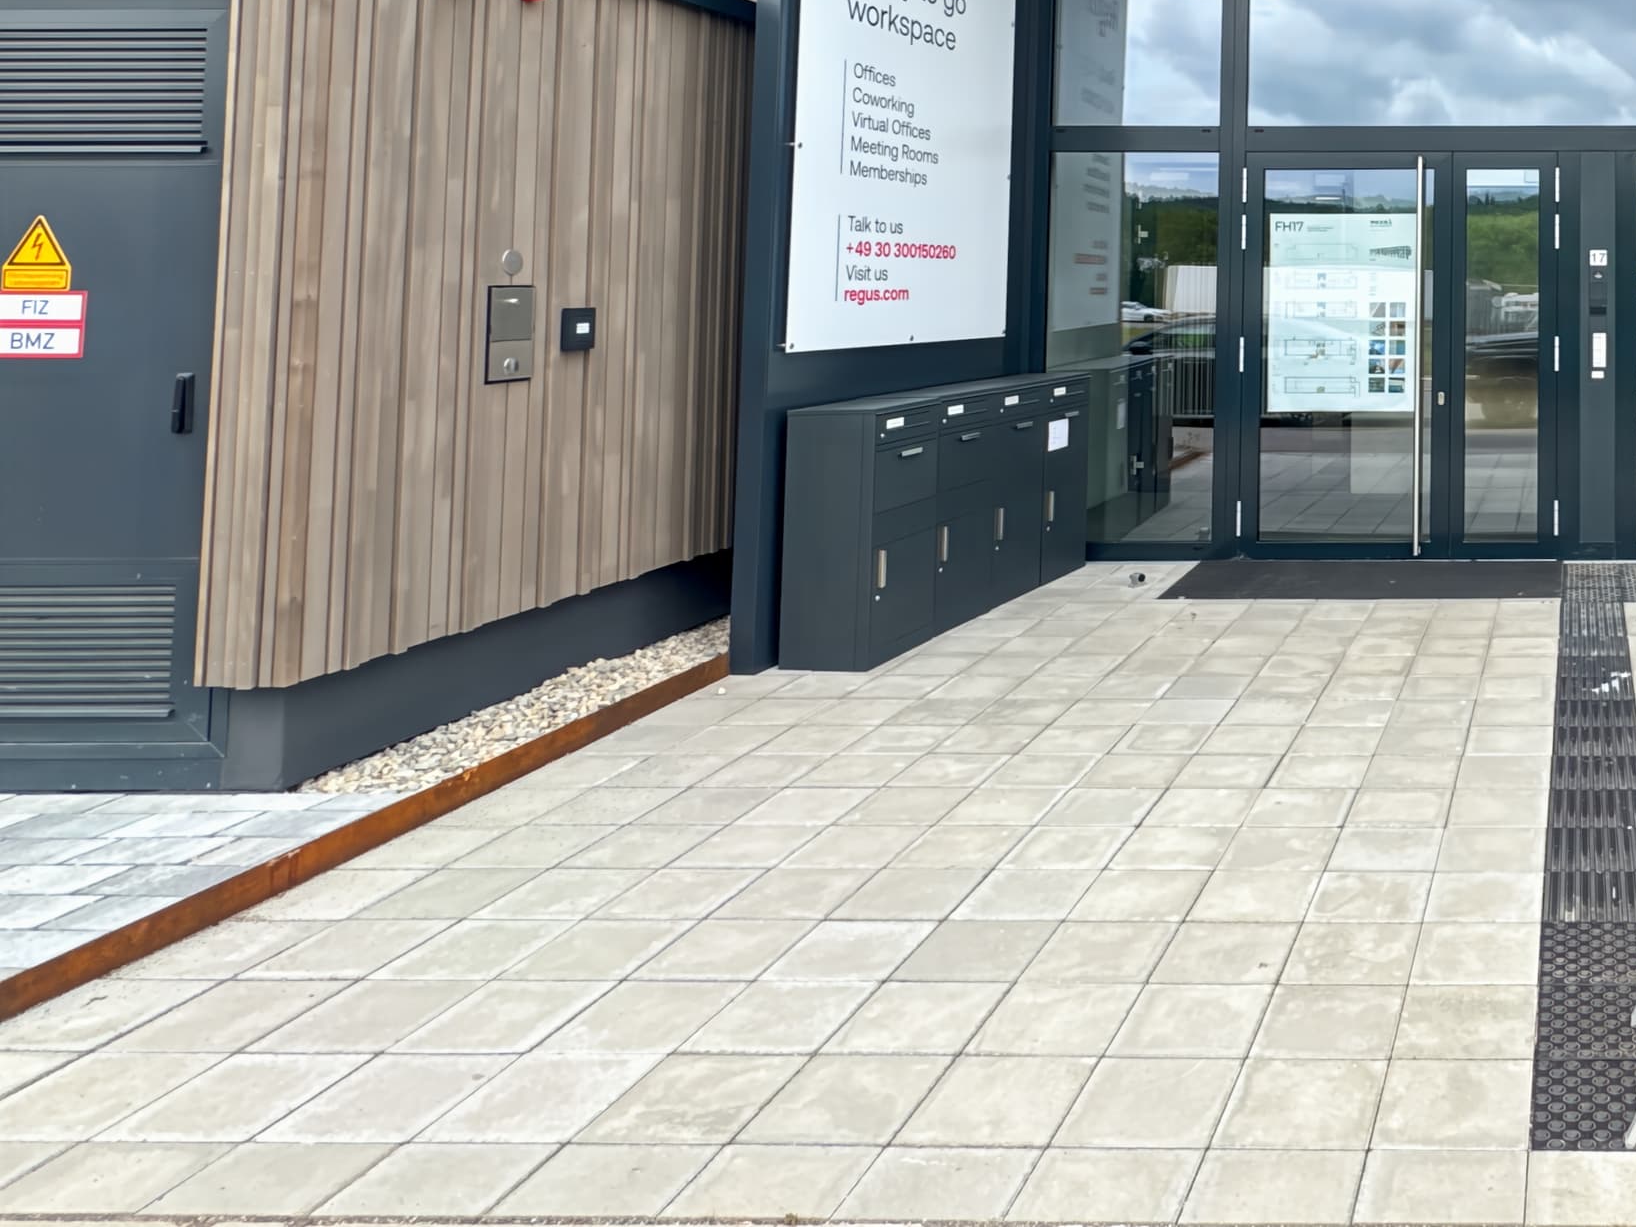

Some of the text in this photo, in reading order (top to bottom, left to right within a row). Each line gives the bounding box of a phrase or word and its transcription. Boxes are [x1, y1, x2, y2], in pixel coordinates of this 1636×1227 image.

[853, 62, 897, 87] Offices
[852, 86, 915, 119] Coworking
[851, 110, 931, 141] Virtual Offices
[850, 135, 939, 165] Meeting Rooms
[849, 159, 928, 188] Memberships
[847, 215, 904, 235] Talk to us
[1274, 221, 1304, 232] FH17
[846, 241, 956, 260] +49 30 300150260
[1591, 253, 1606, 263] 17
[845, 264, 889, 281] Visit us
[843, 288, 910, 306] regus.com
[20, 299, 50, 316] FIZ
[10, 332, 55, 350] BMZ
